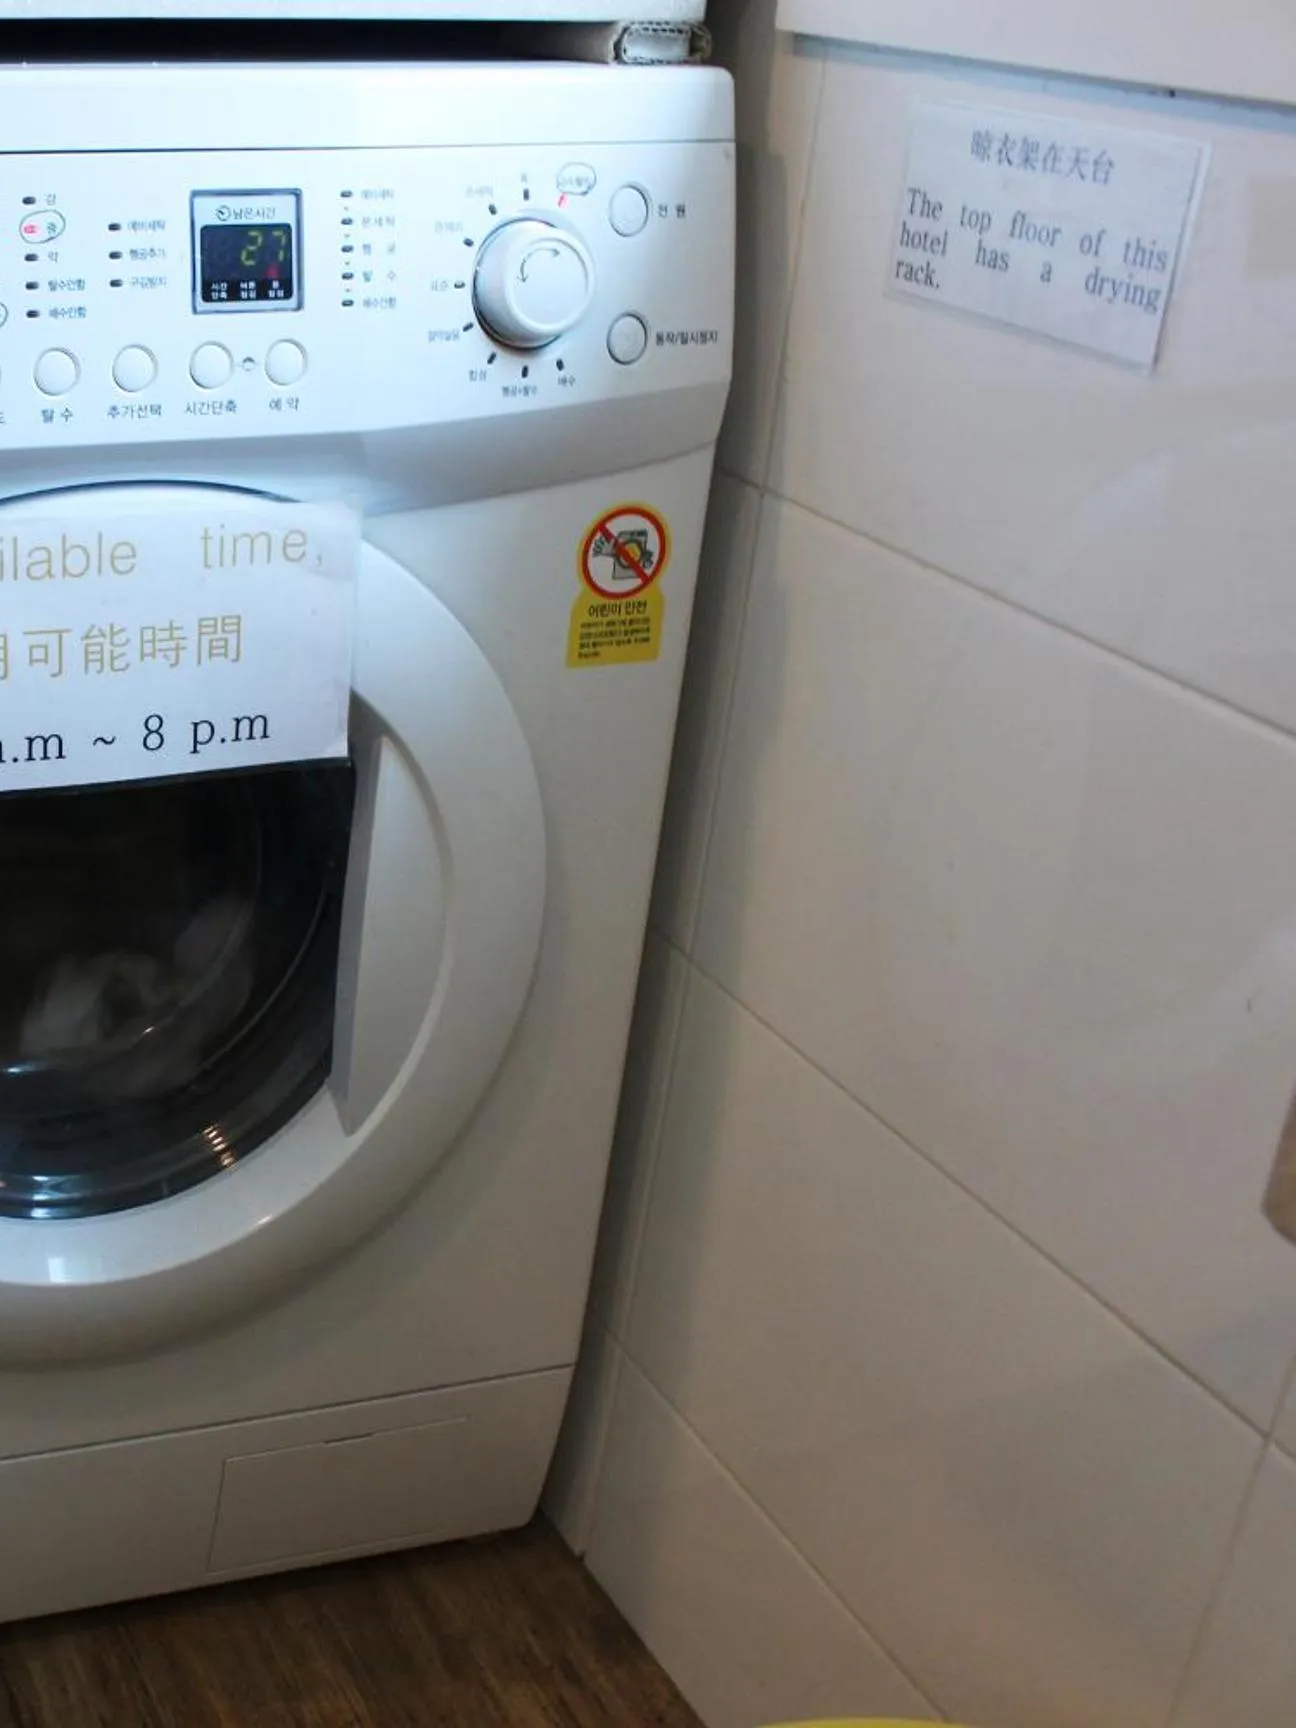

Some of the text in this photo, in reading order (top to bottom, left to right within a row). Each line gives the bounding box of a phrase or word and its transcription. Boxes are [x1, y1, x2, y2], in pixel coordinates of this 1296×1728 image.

[240, 230, 287, 266] 27
[906, 187, 1169, 273] The top floor of this
[894, 258, 940, 290] rack.
[899, 220, 1162, 314] hotel has a drying
[106, 404, 163, 420] 추가선택
[183, 397, 238, 416] 시간단축
[199, 521, 324, 571] time,
[141, 713, 165, 752] 8
[189, 712, 271, 754] p.m
